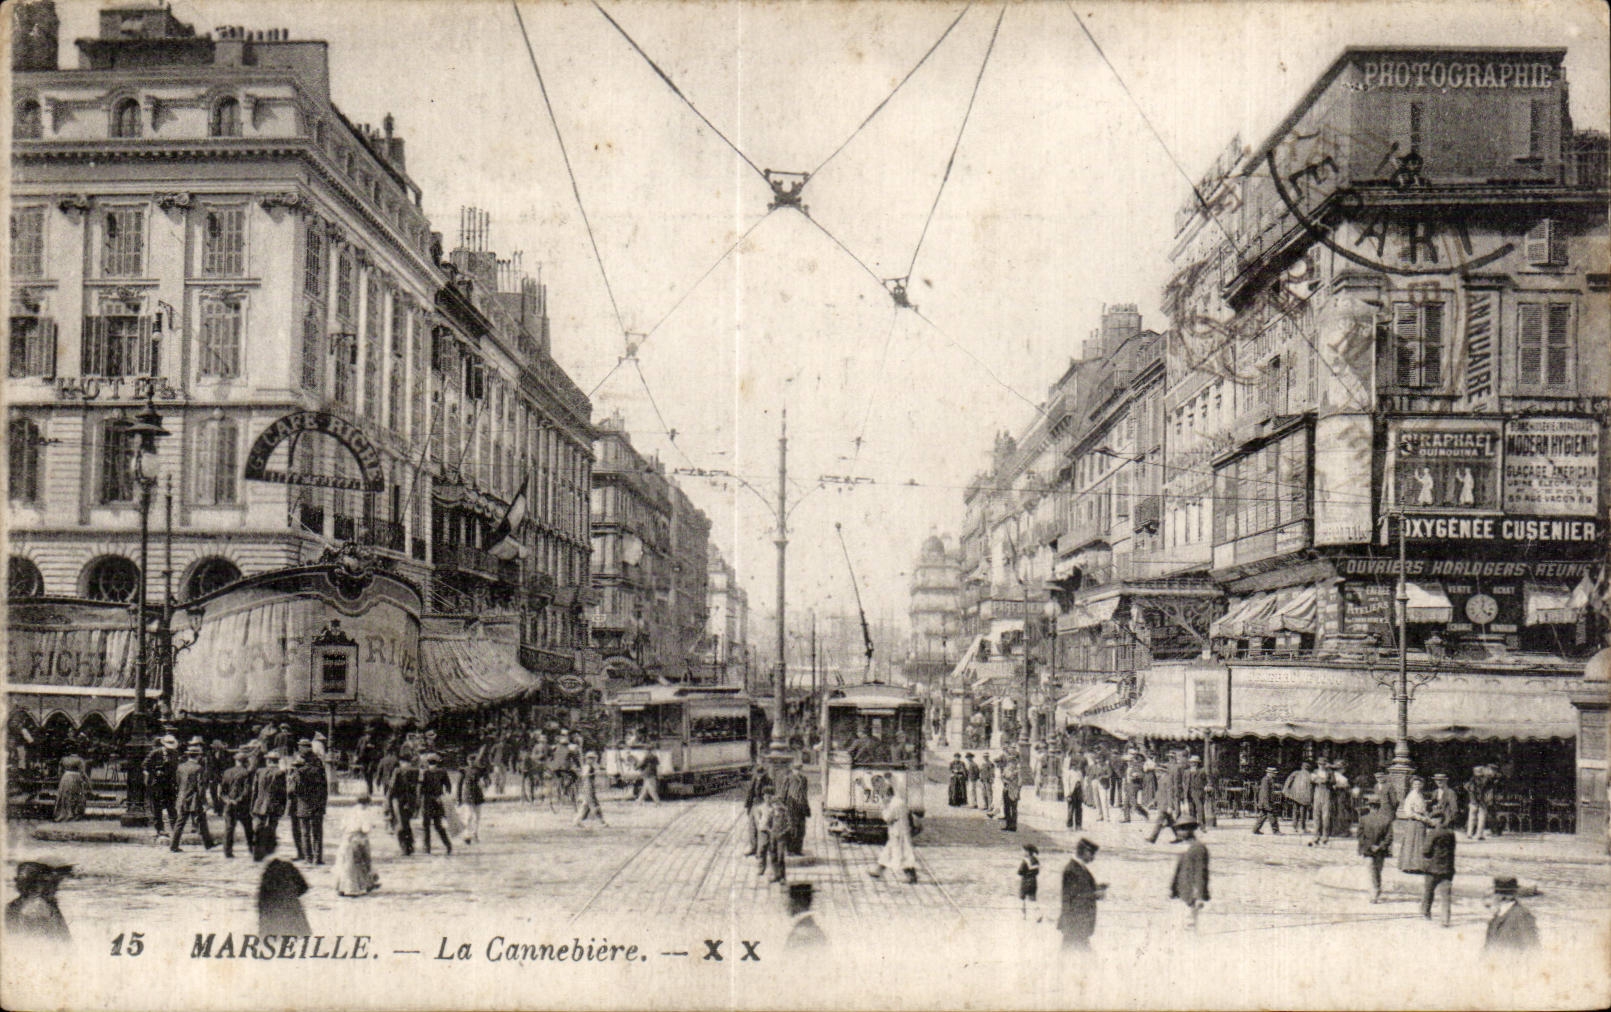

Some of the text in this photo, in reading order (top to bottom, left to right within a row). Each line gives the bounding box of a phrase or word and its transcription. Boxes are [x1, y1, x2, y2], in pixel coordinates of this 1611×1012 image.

[1365, 62, 1553, 88] PHOTOGRAPHIE
[1468, 293, 1491, 403] ANNUAIRE
[1419, 448, 1479, 456] QUINQUINA
[1507, 434, 1548, 457] MODERN
[1502, 519, 1596, 541] CUSENIER
[1346, 559, 1424, 575] OUVRIERS
[1431, 561, 1527, 577] HORLOGERS
